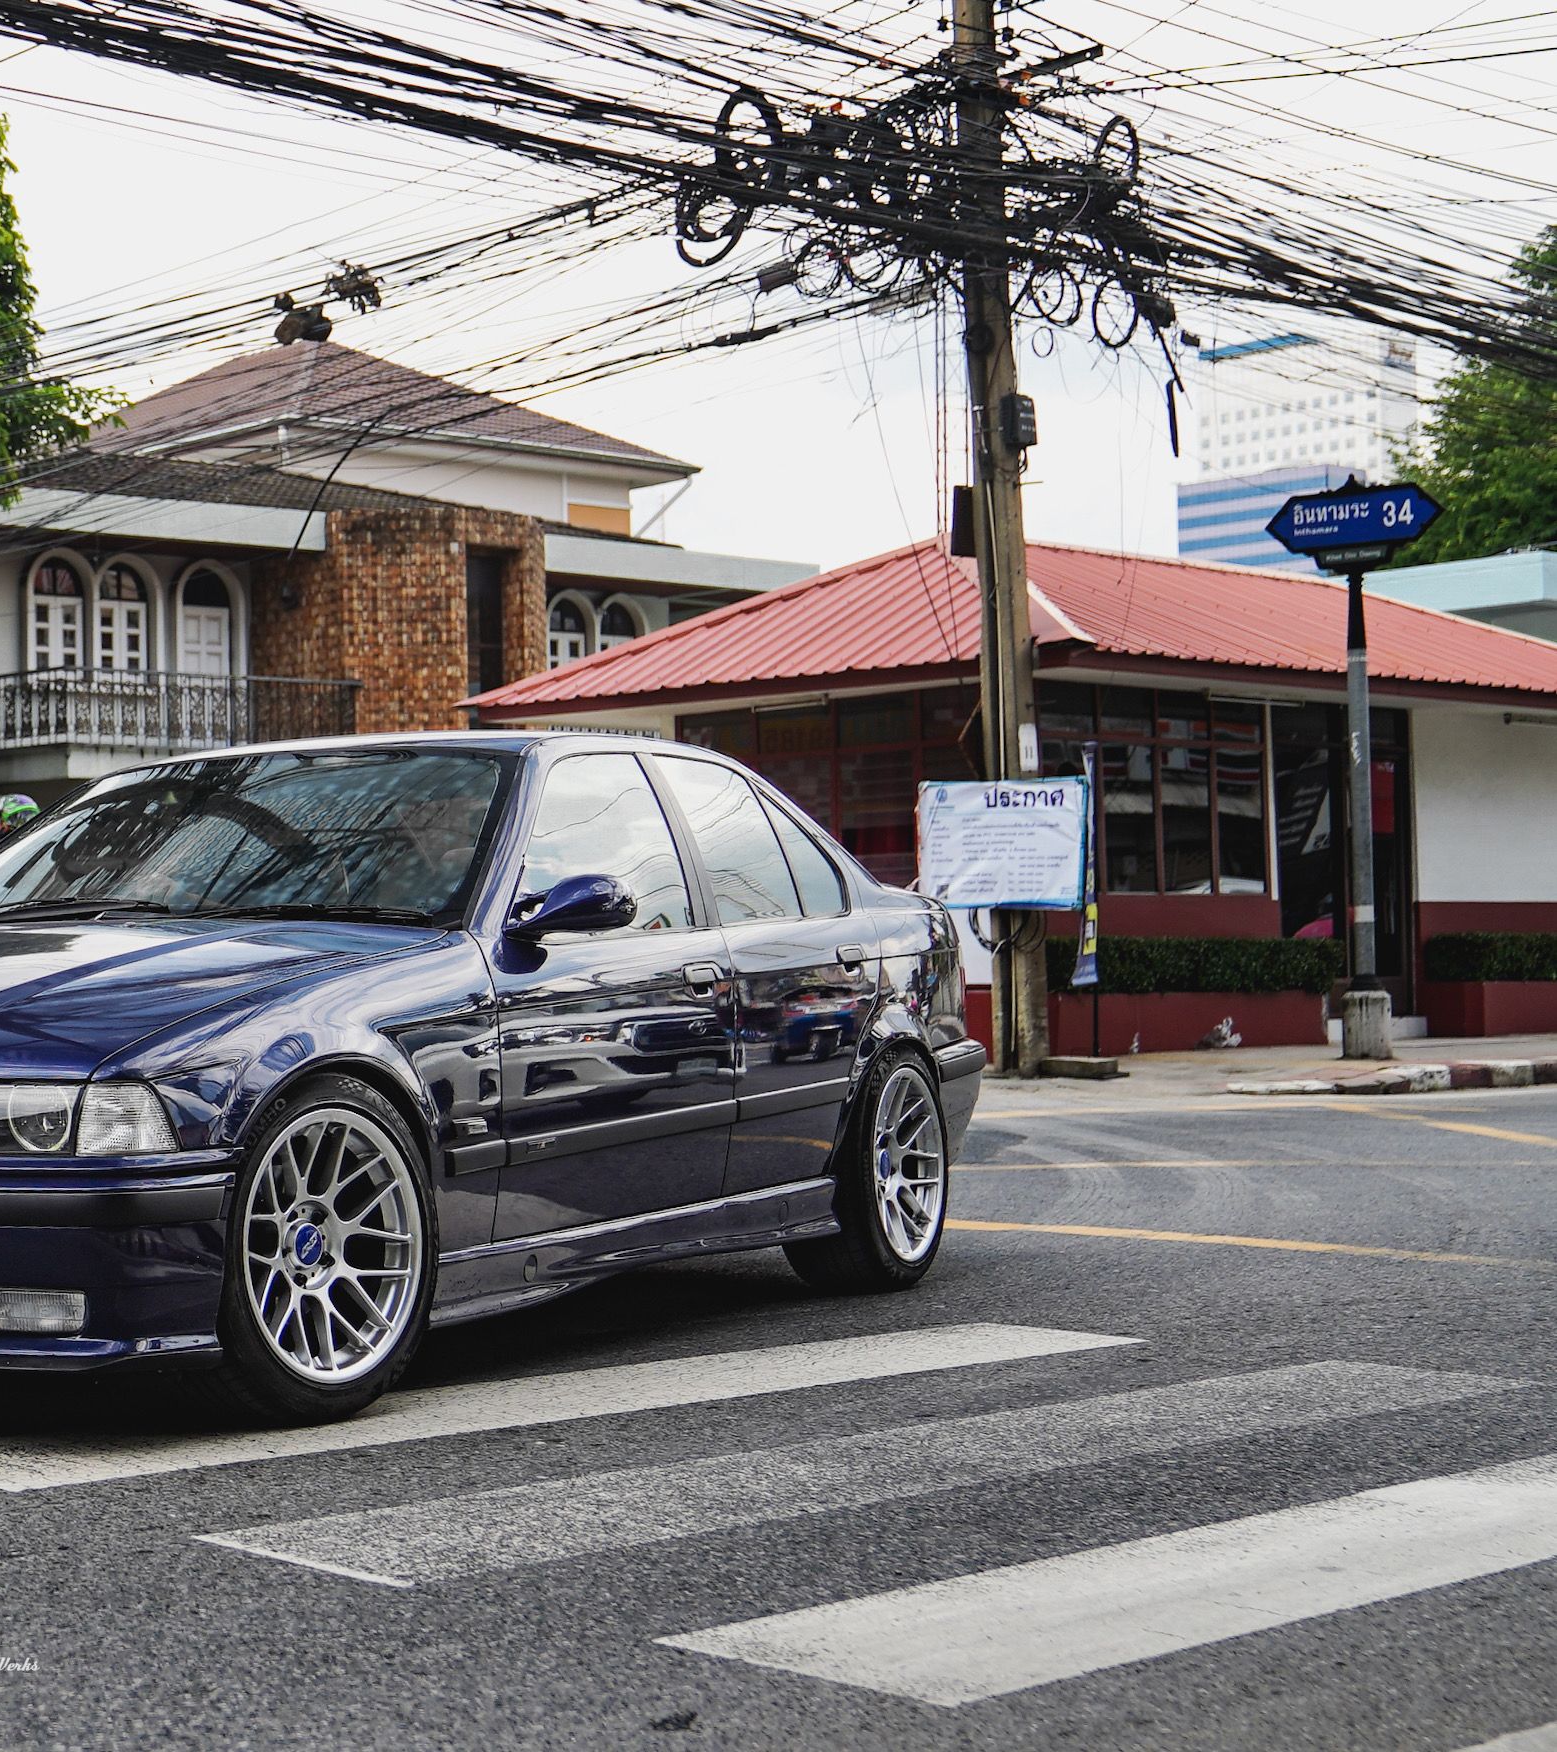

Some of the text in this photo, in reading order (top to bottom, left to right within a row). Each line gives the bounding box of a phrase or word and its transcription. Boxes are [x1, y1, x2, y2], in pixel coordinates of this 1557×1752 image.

[1293, 498, 1414, 528] อินทามระ 34
[984, 787, 1064, 809] ประกาศ
